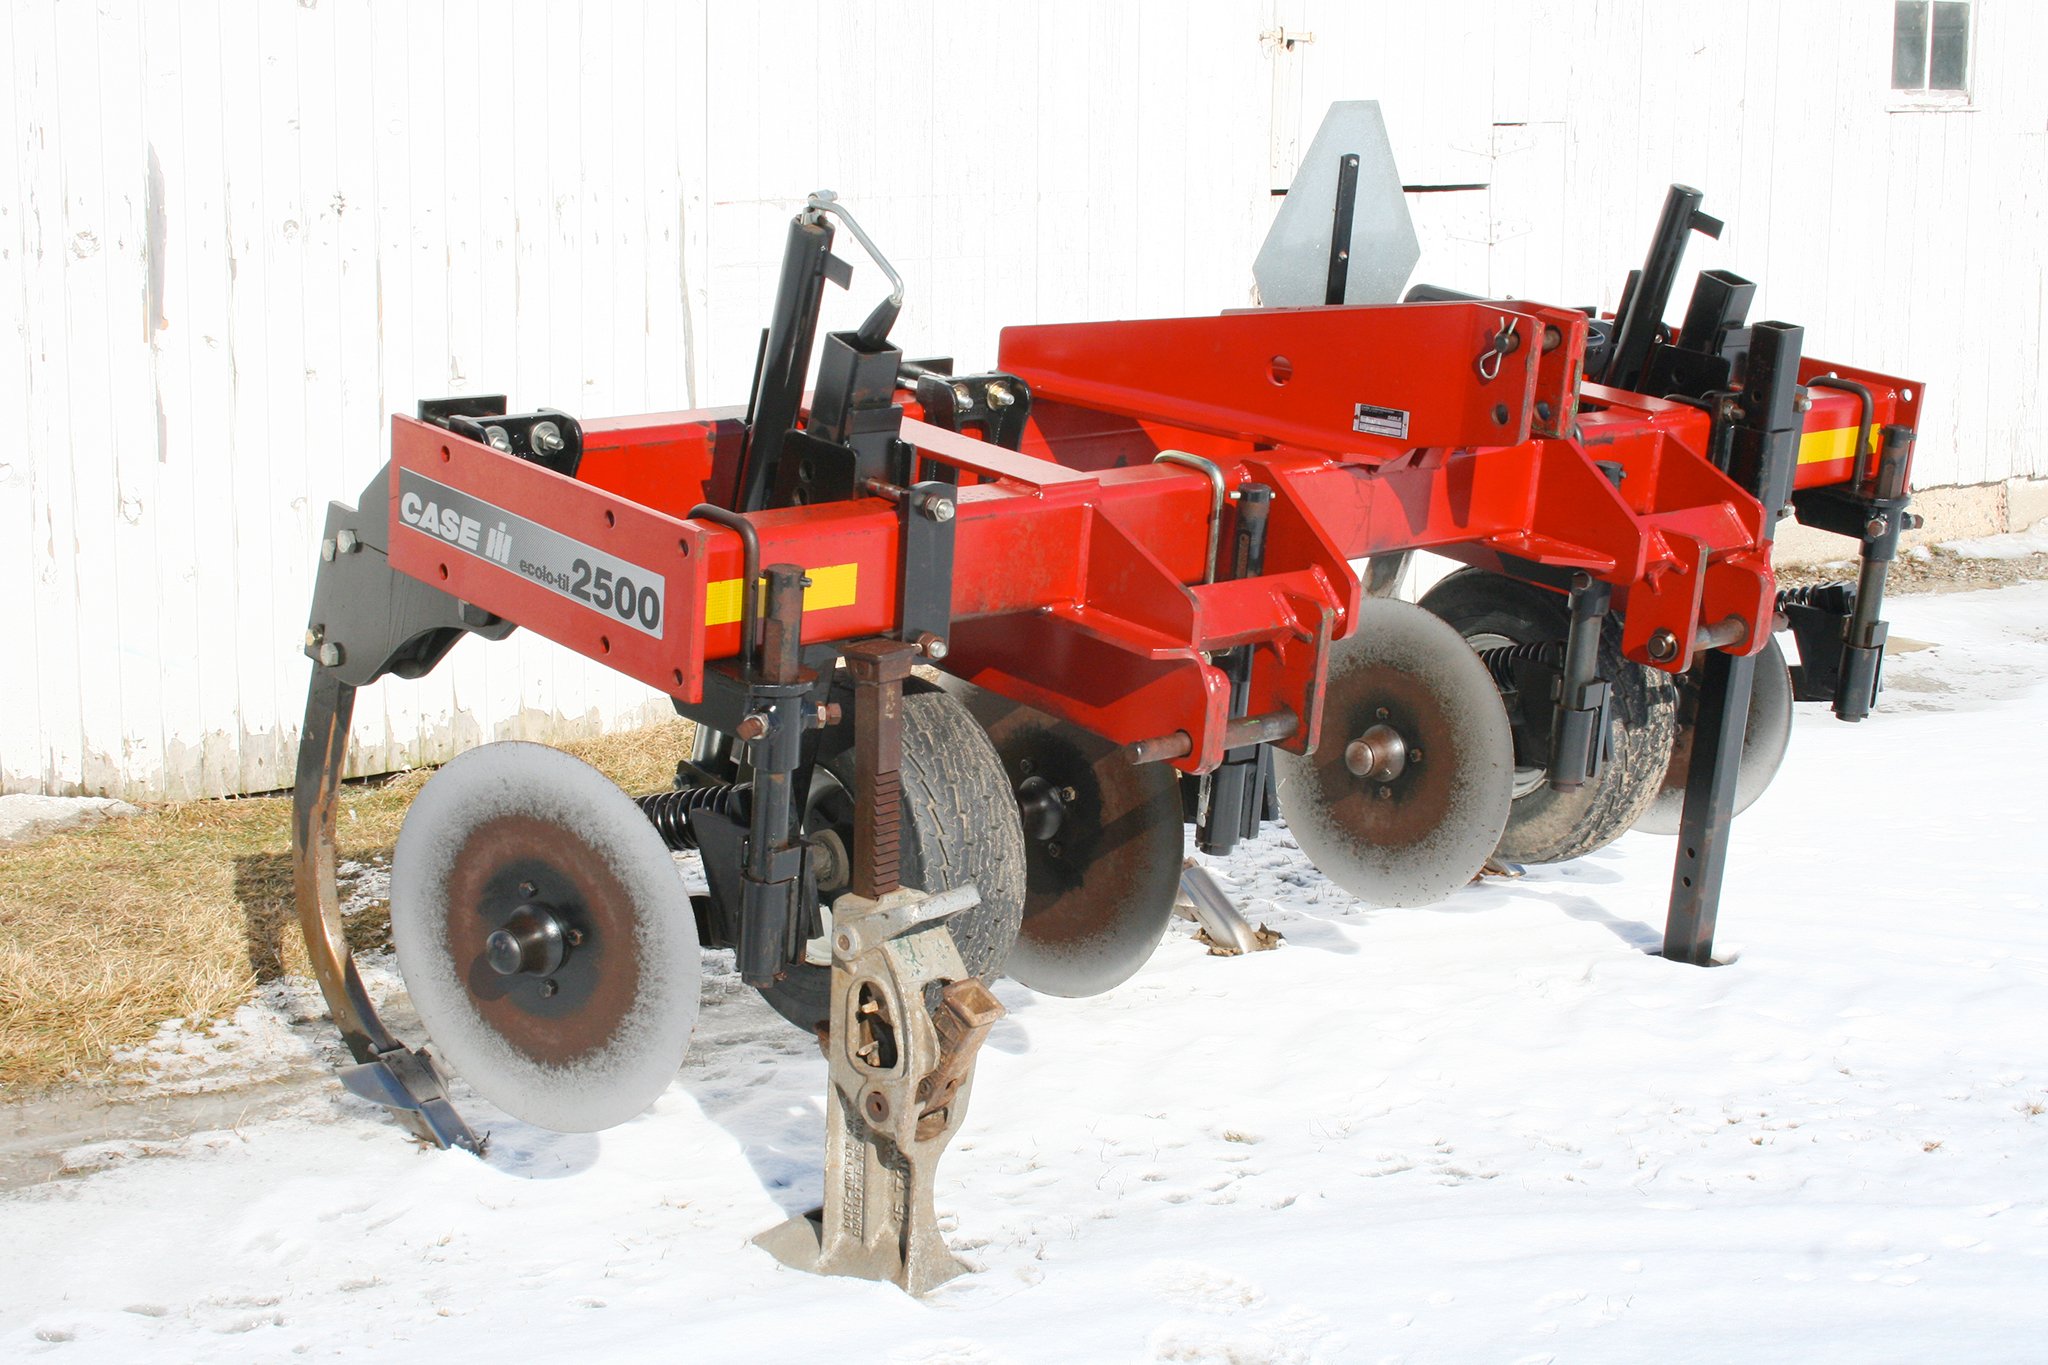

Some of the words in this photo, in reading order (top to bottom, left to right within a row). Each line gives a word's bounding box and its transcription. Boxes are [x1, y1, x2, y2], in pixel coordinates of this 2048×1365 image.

[401, 492, 481, 551] CASE
[519, 558, 570, 593] ecolo-til
[570, 558, 660, 630] 2500
